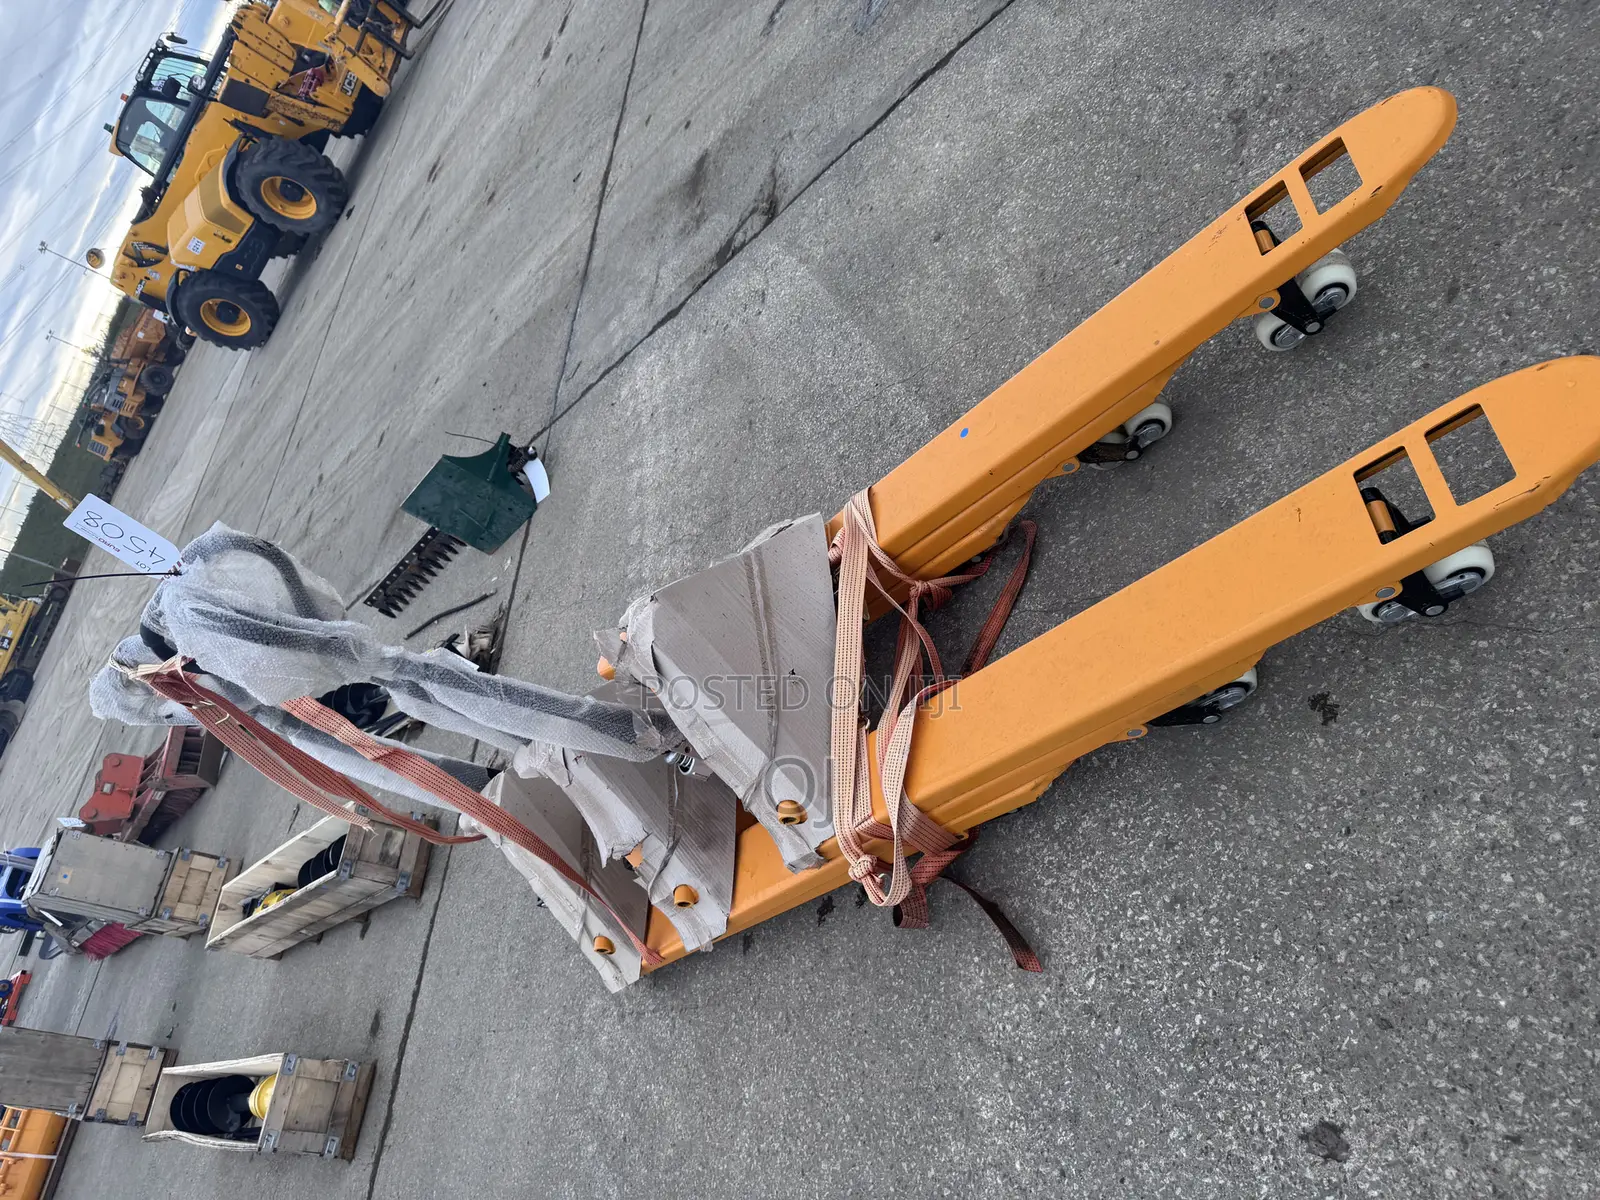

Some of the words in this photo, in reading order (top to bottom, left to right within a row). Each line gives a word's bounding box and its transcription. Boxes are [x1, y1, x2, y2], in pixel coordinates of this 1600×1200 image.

[342, 72, 358, 96] JCB
[82, 510, 166, 565] 4508
[97, 537, 121, 553] EURO
[135, 560, 152, 572] LOT
